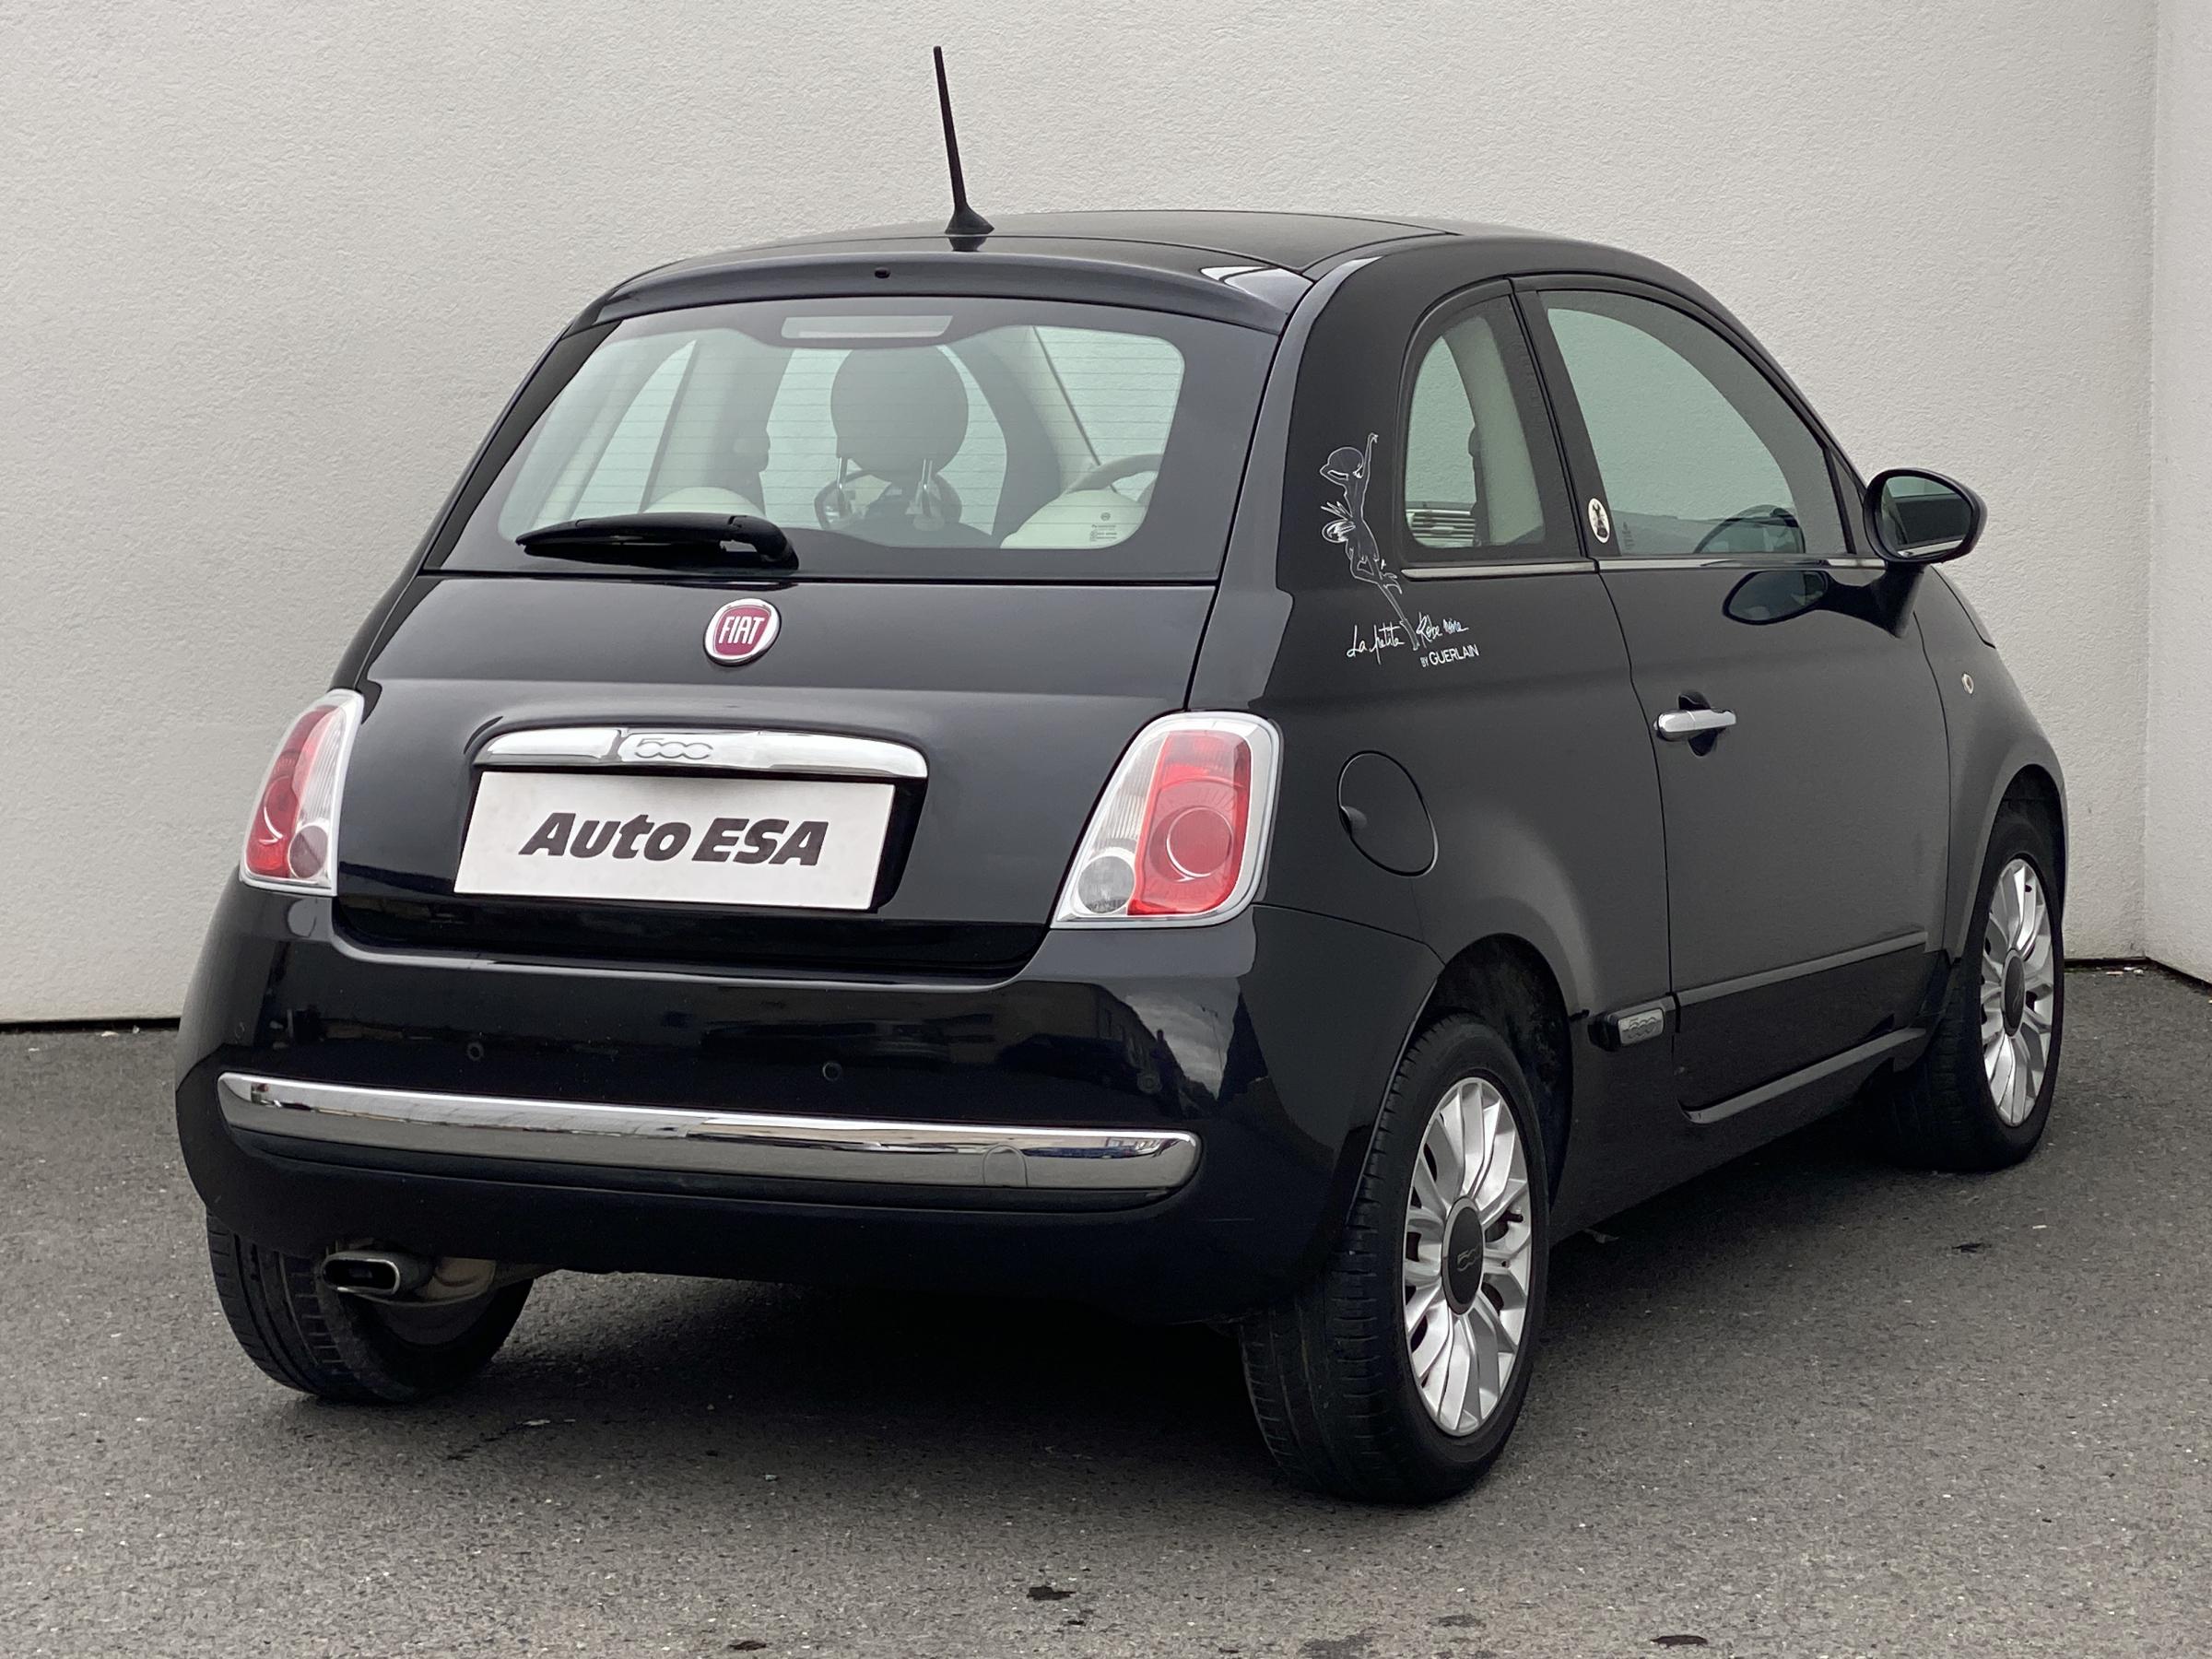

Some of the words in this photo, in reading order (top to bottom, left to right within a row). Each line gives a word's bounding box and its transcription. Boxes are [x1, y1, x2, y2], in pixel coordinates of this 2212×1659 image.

[718, 616, 765, 644] FIAT
[1346, 624, 1367, 658] La
[1369, 621, 1405, 665] petite
[1429, 643, 1479, 665] GUERLAIN
[634, 737, 713, 760] 500
[518, 812, 691, 861] Auto
[691, 818, 829, 865] ESA
